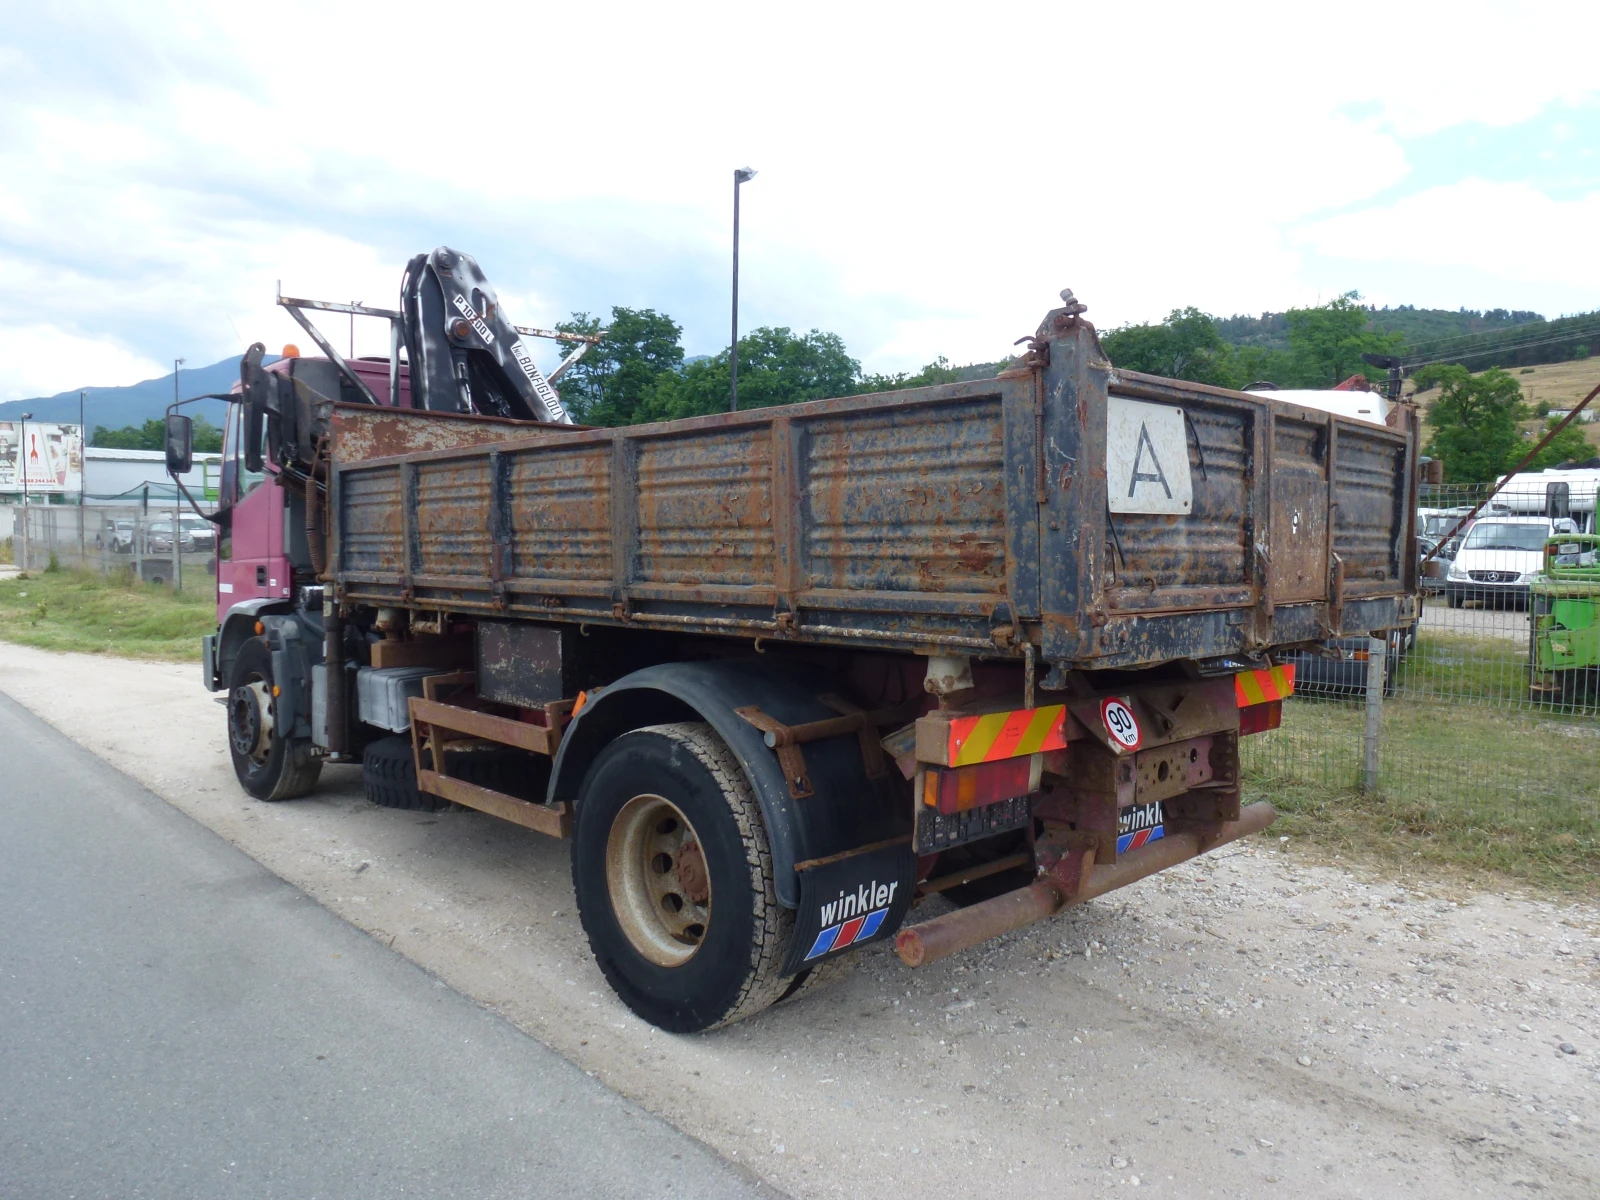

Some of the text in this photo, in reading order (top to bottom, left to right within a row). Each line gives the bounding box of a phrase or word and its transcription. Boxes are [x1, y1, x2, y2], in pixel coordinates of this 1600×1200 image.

[519, 356, 563, 416] BONFIGLIOLI
[1127, 420, 1173, 500] A
[1108, 706, 1132, 733] 90
[1122, 733, 1137, 744] km
[1119, 801, 1163, 834] winkl
[820, 880, 898, 928] winkler
